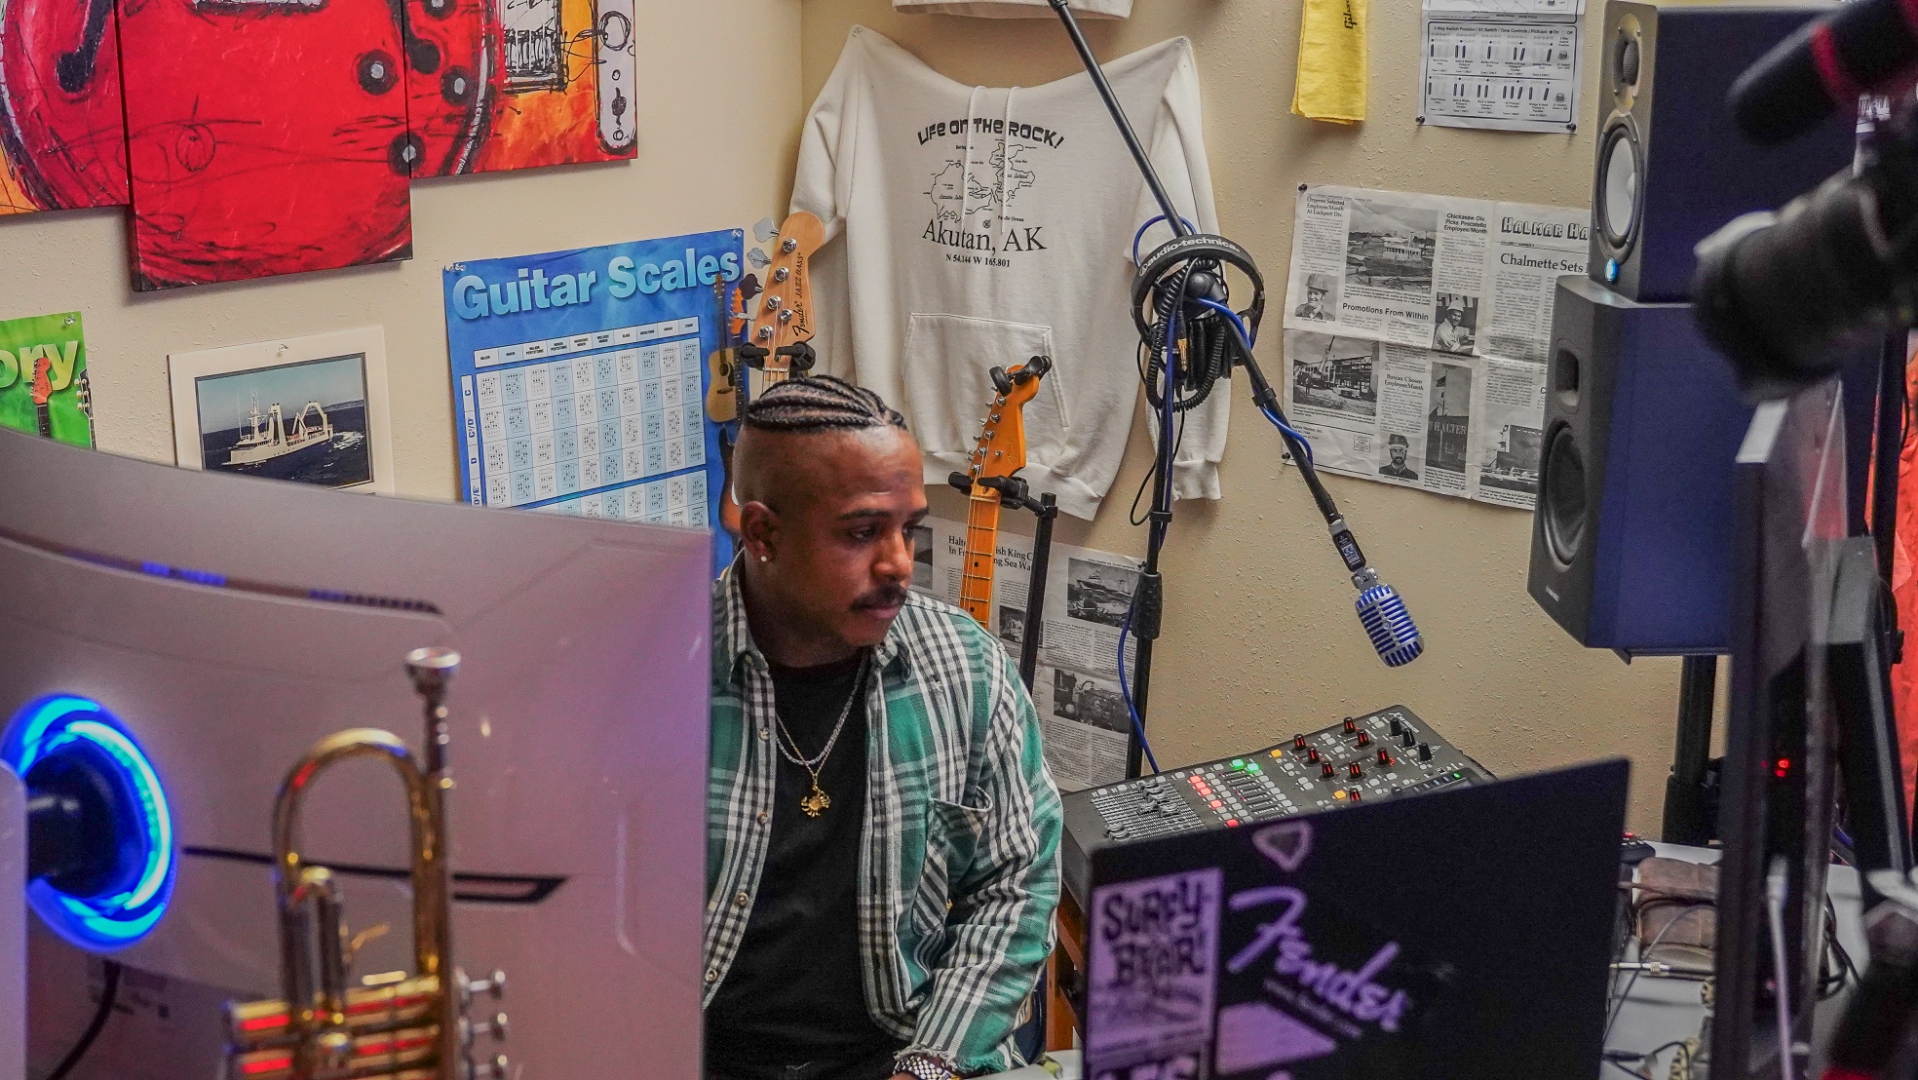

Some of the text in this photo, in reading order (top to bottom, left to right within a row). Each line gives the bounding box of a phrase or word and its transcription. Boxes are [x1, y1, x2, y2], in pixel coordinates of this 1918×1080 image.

[1501, 216, 1563, 239] HALMAR
[922, 219, 1047, 256] Akutan, AK
[973, 256, 982, 265] W
[1500, 252, 1584, 273] Chalmette Sets
[452, 248, 740, 320] Guitar Scales
[1342, 303, 1429, 320] Promotions From Within
[1433, 421, 1467, 435] HALTER
[470, 457, 477, 465] D
[1008, 548, 1026, 560] King
[1004, 557, 1018, 568] Sea
